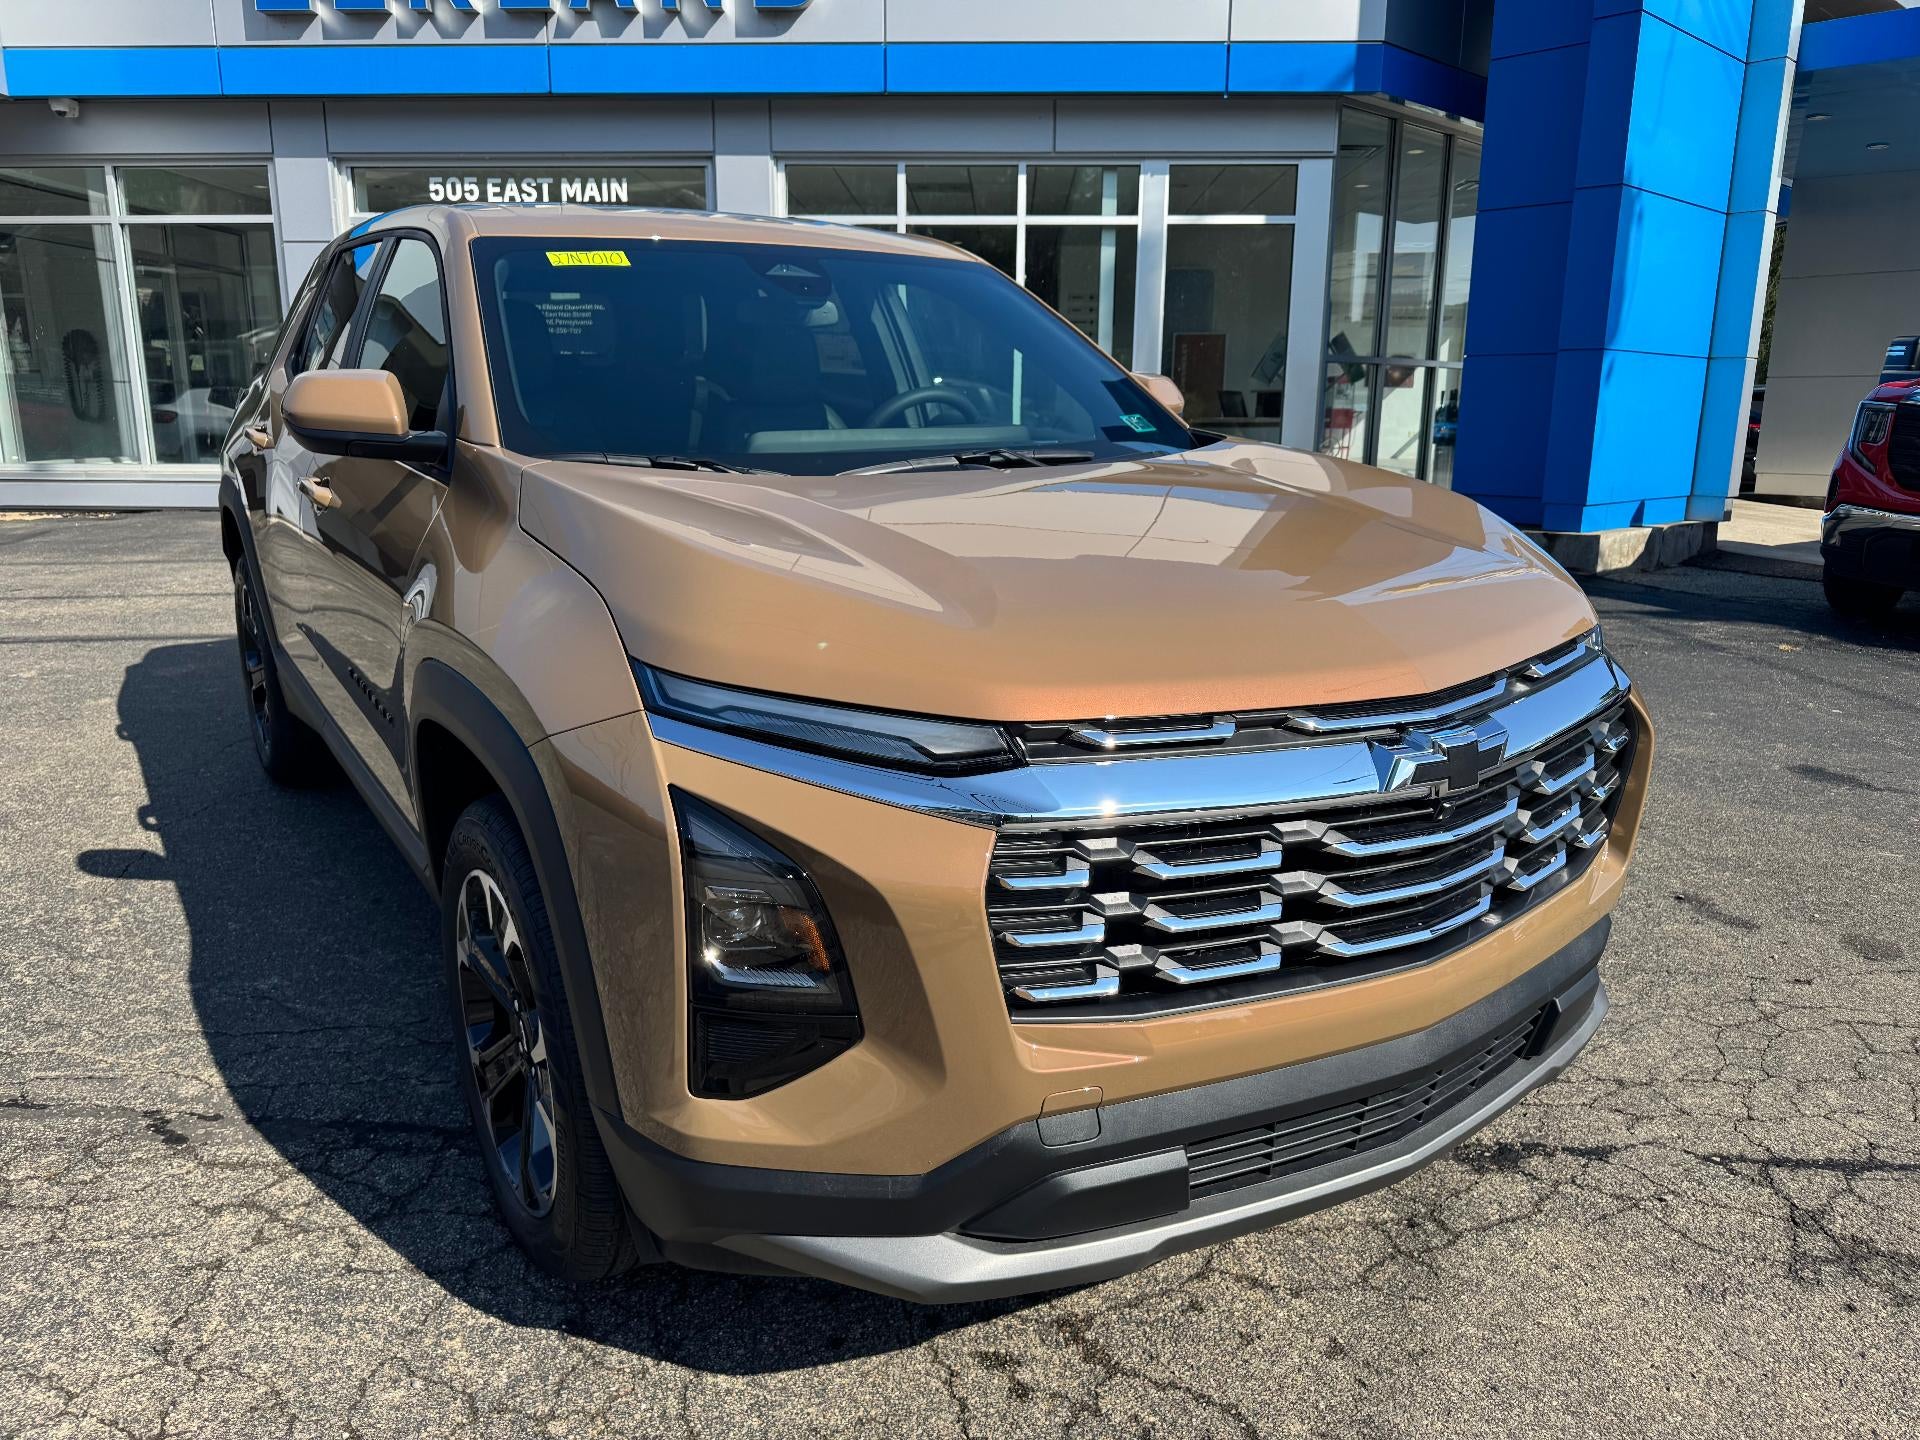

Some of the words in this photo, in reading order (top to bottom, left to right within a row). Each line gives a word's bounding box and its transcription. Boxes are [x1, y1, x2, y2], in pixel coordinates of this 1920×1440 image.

[428, 176, 480, 202] 505
[486, 177, 554, 203] EAST
[560, 177, 629, 203] MAIN
